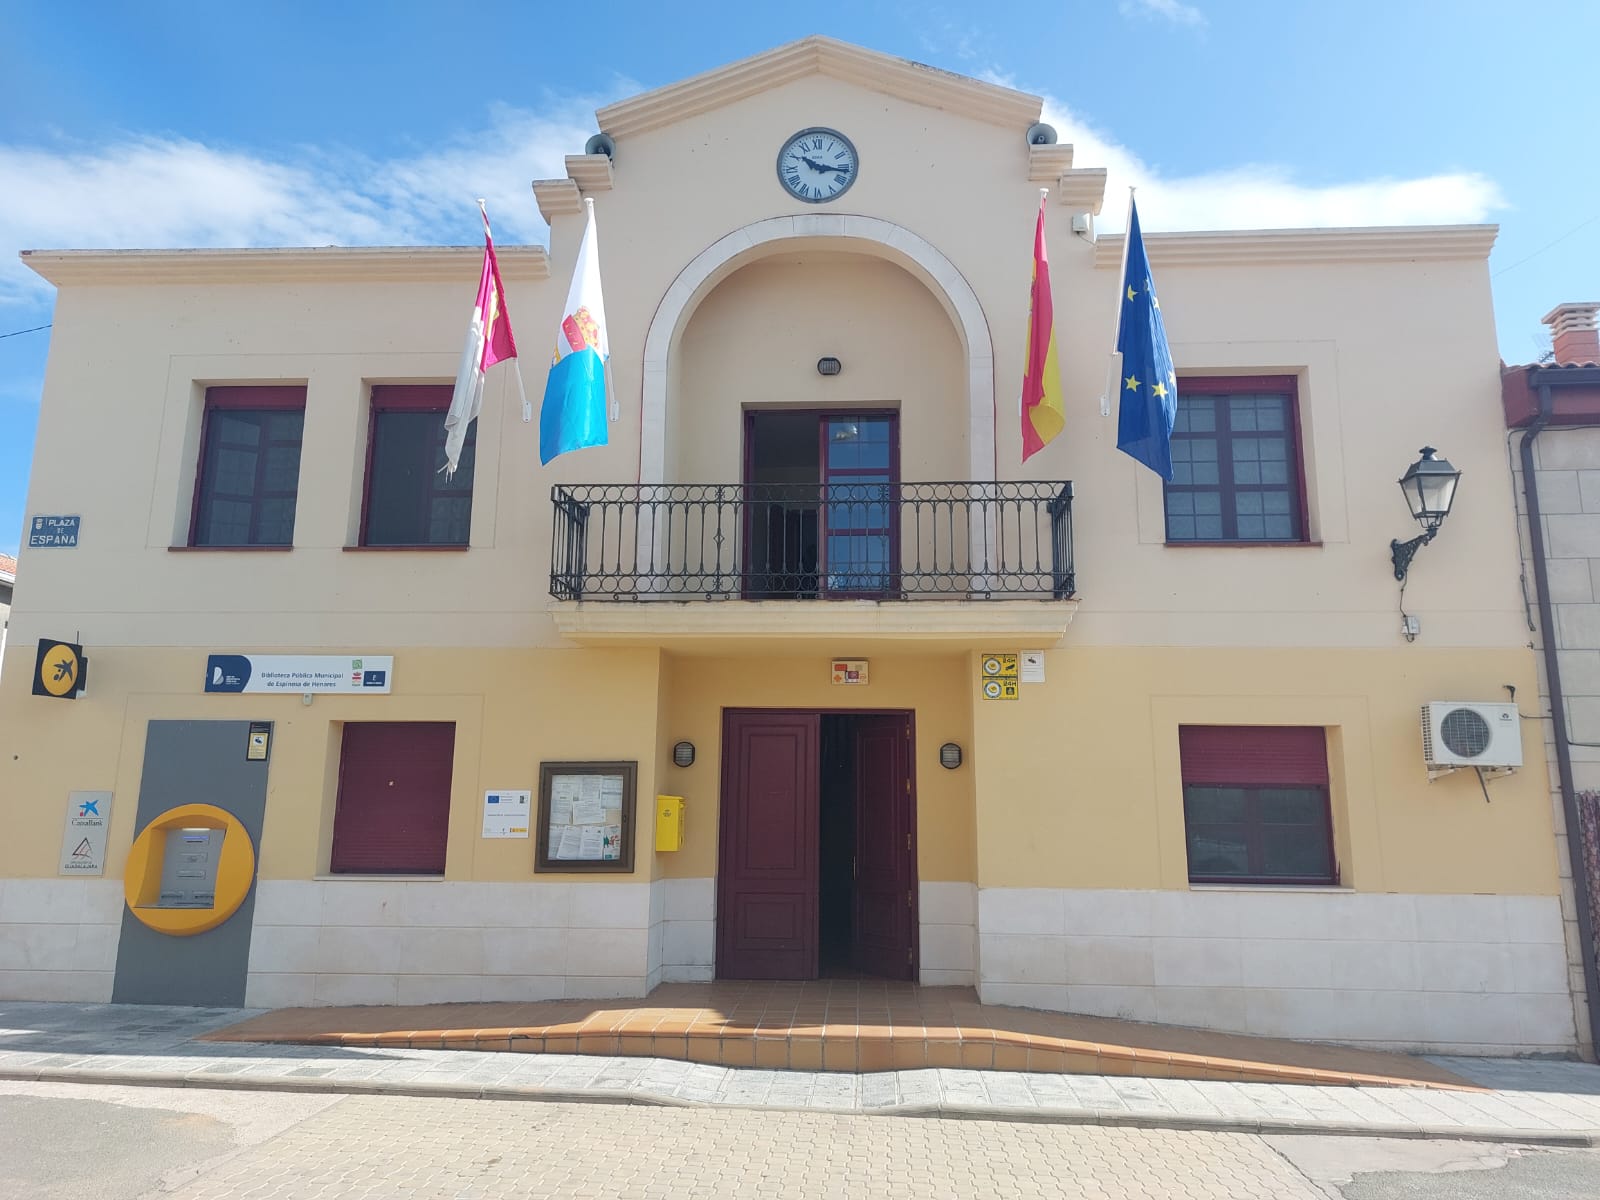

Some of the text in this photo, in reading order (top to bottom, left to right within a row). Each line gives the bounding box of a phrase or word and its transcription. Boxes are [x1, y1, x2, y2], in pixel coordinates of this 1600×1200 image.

[812, 138, 822, 150] XII
[261, 671, 344, 680] Biblioteca Pública Municipal
